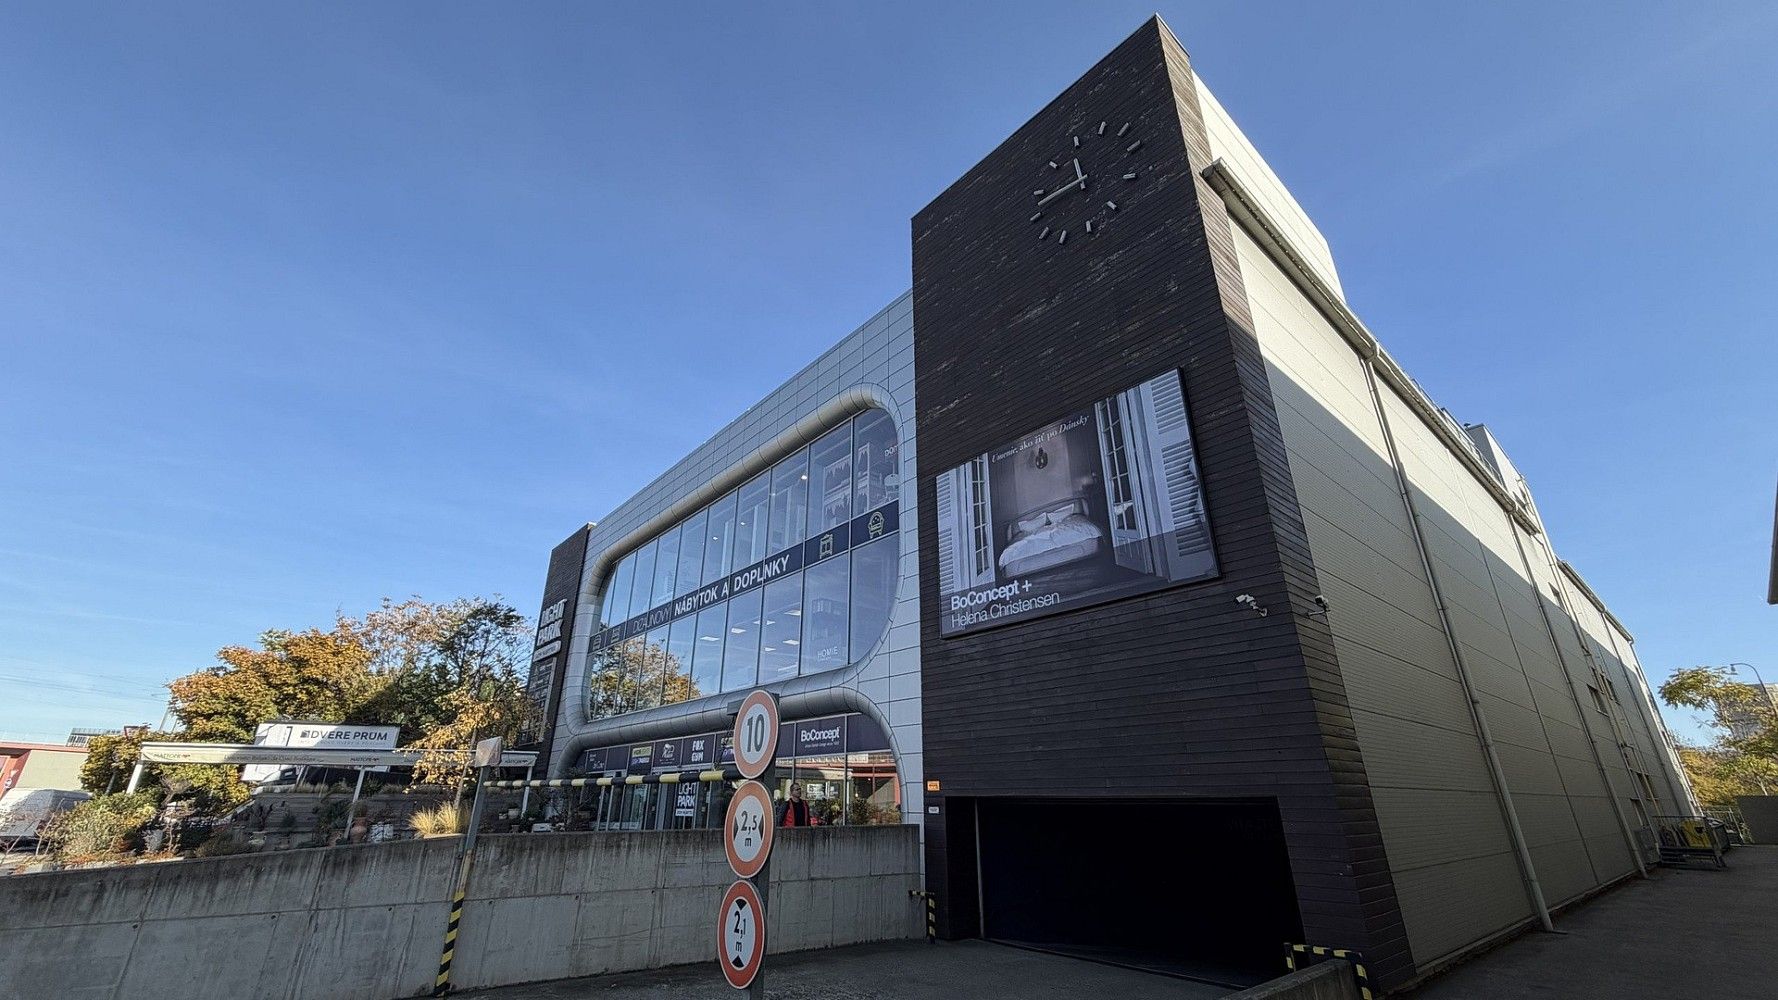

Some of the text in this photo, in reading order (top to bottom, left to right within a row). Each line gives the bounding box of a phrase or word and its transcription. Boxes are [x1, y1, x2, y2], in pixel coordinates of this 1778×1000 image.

[674, 586, 719, 617] NÁBYTOK
[721, 584, 729, 598] A
[734, 554, 790, 592] DOPLNKY
[951, 580, 1020, 611] BoConcept
[540, 598, 567, 628] LIGHT
[952, 592, 1060, 628] Helena Christensen
[537, 619, 564, 647] PARK
[310, 730, 350, 740] DVERE
[746, 714, 765, 754] 10
[800, 727, 841, 742] BoConcept
[677, 795, 696, 808] PARK
[679, 782, 697, 795] LIGHT
[741, 811, 758, 835] 2,5
[744, 838, 752, 848] m
[733, 911, 747, 939] 2,1
